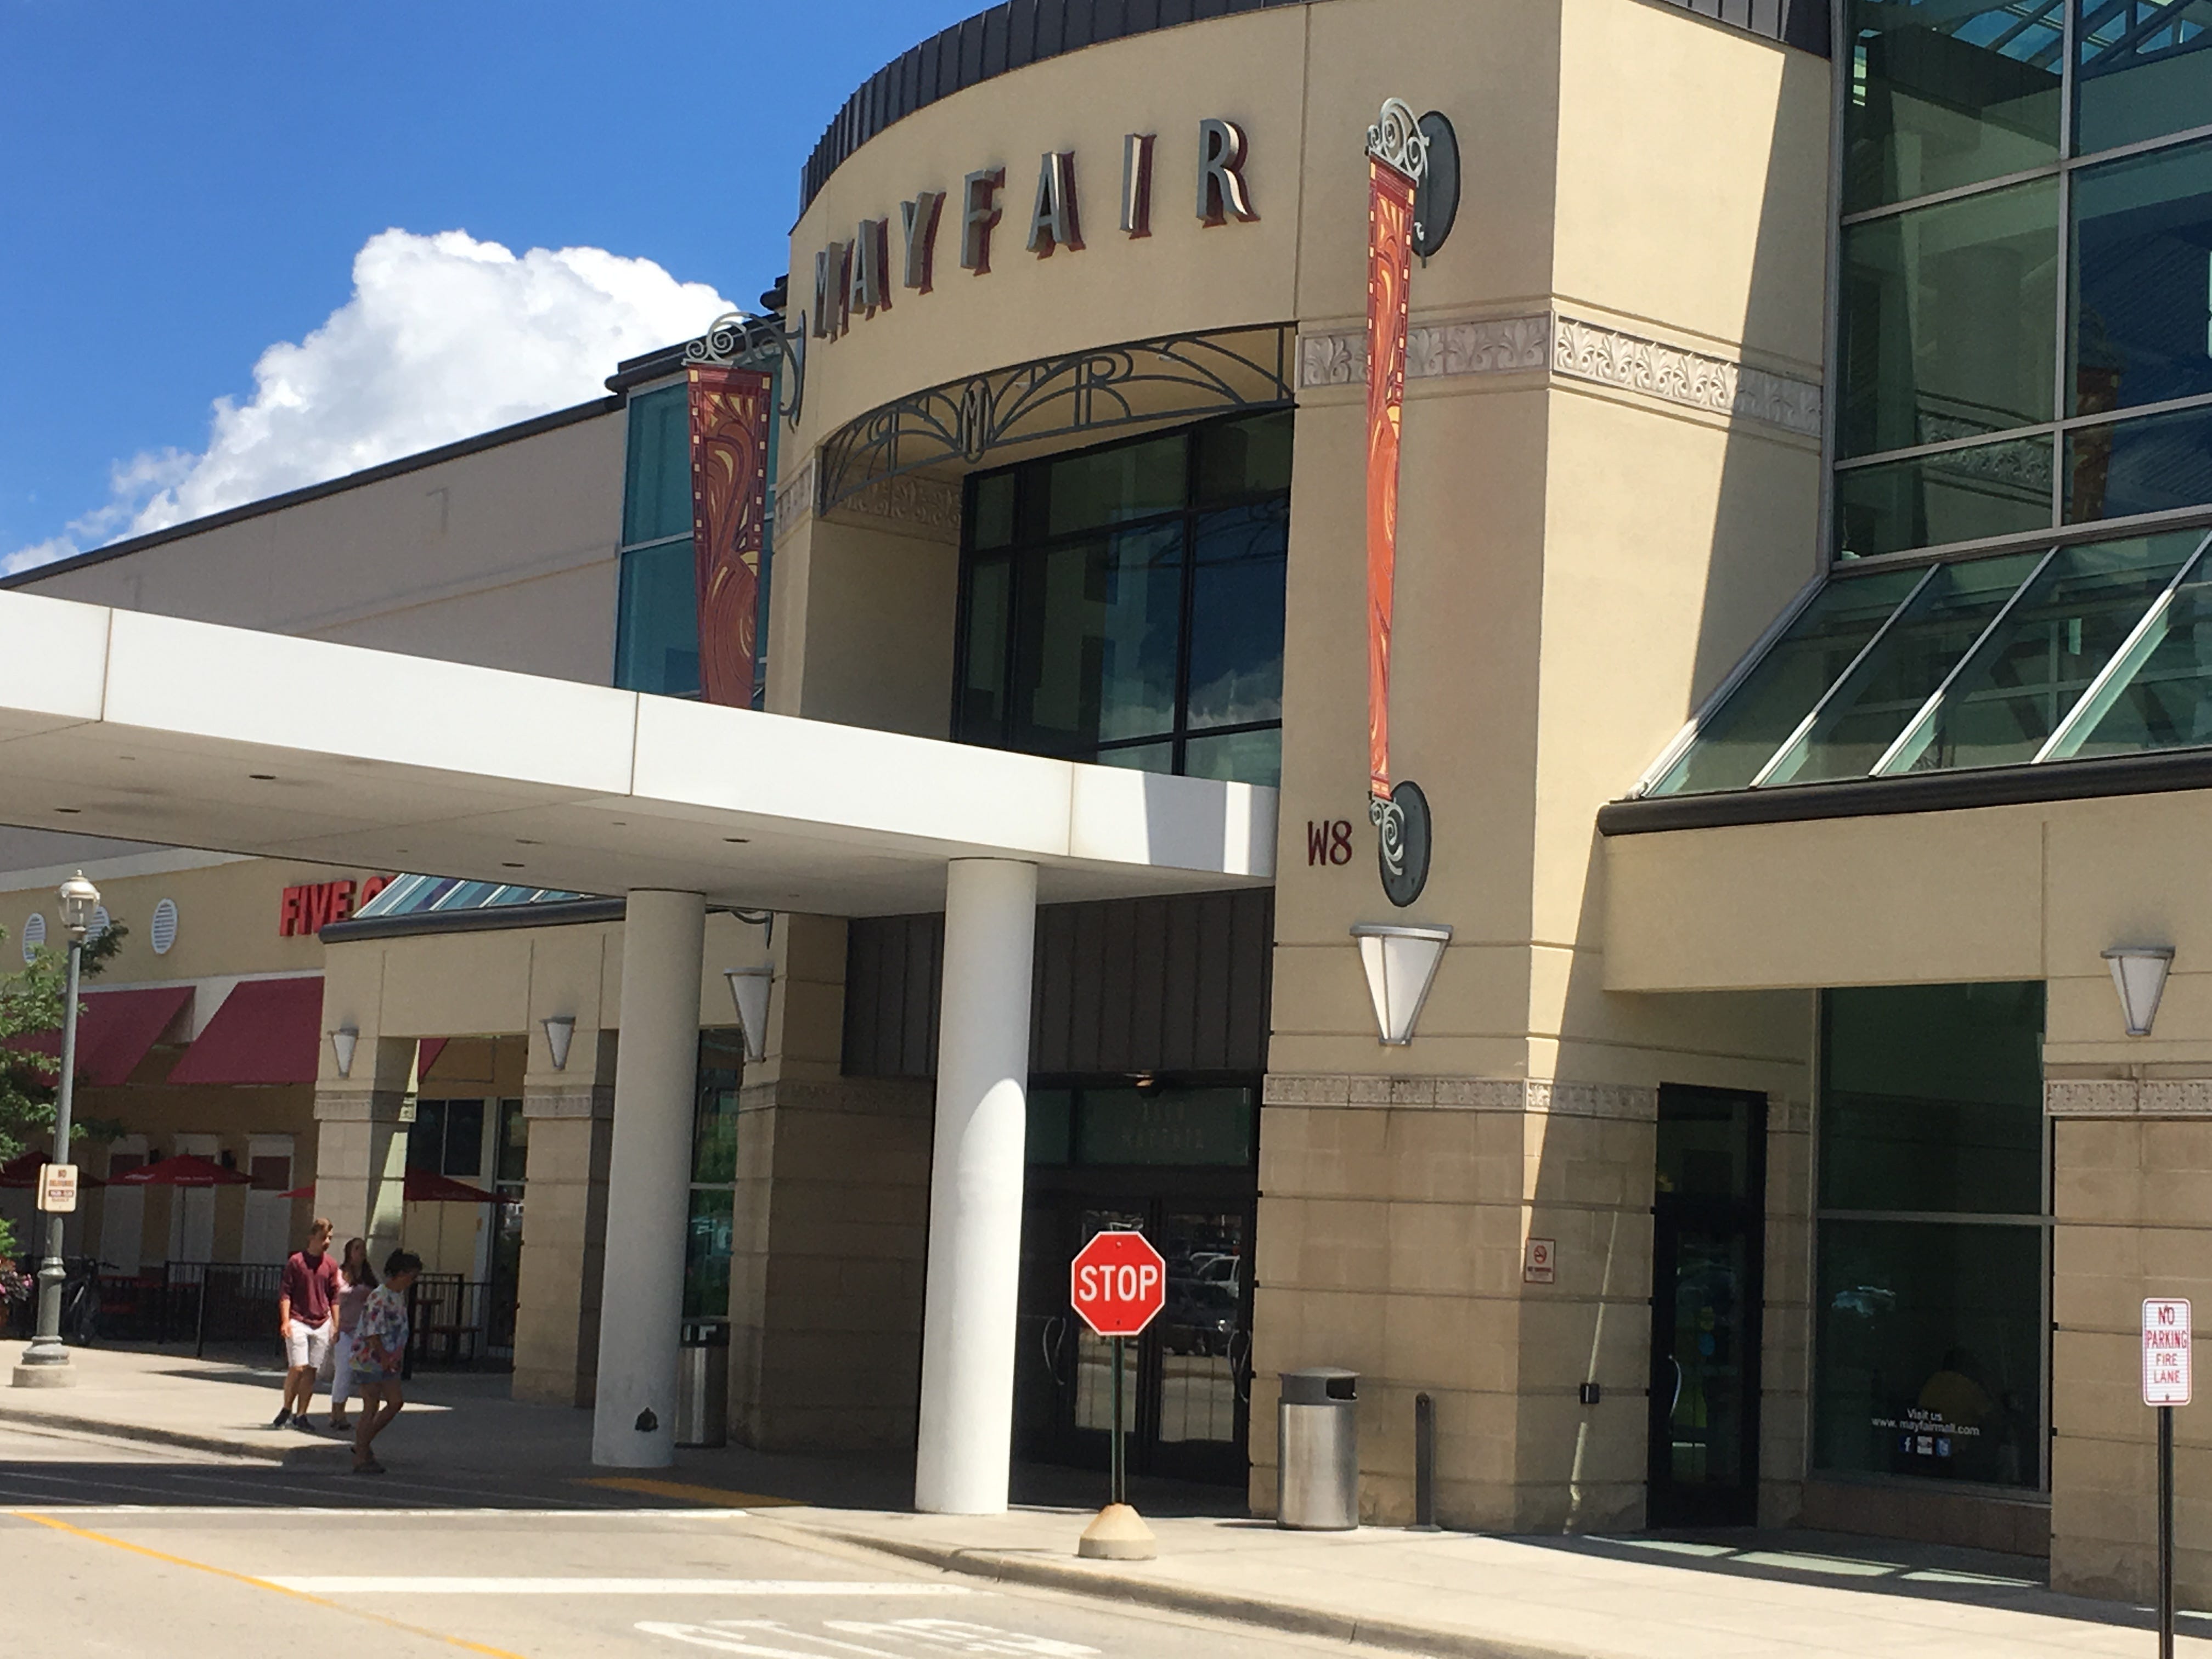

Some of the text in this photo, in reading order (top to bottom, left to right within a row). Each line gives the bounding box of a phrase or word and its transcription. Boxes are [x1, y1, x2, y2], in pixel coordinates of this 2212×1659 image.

[812, 118, 1254, 340] MAYFAIR
[1308, 820, 1352, 866] W8
[279, 880, 356, 937] FIVE
[1079, 1265, 1159, 1302] STOP
[2158, 1306, 2175, 1325] NO
[2146, 1330, 2188, 1349] PARKING
[2156, 1353, 2178, 1366] FIRE
[2154, 1370, 2180, 1384] LANE
[1906, 1408, 1943, 1421] Visit us
